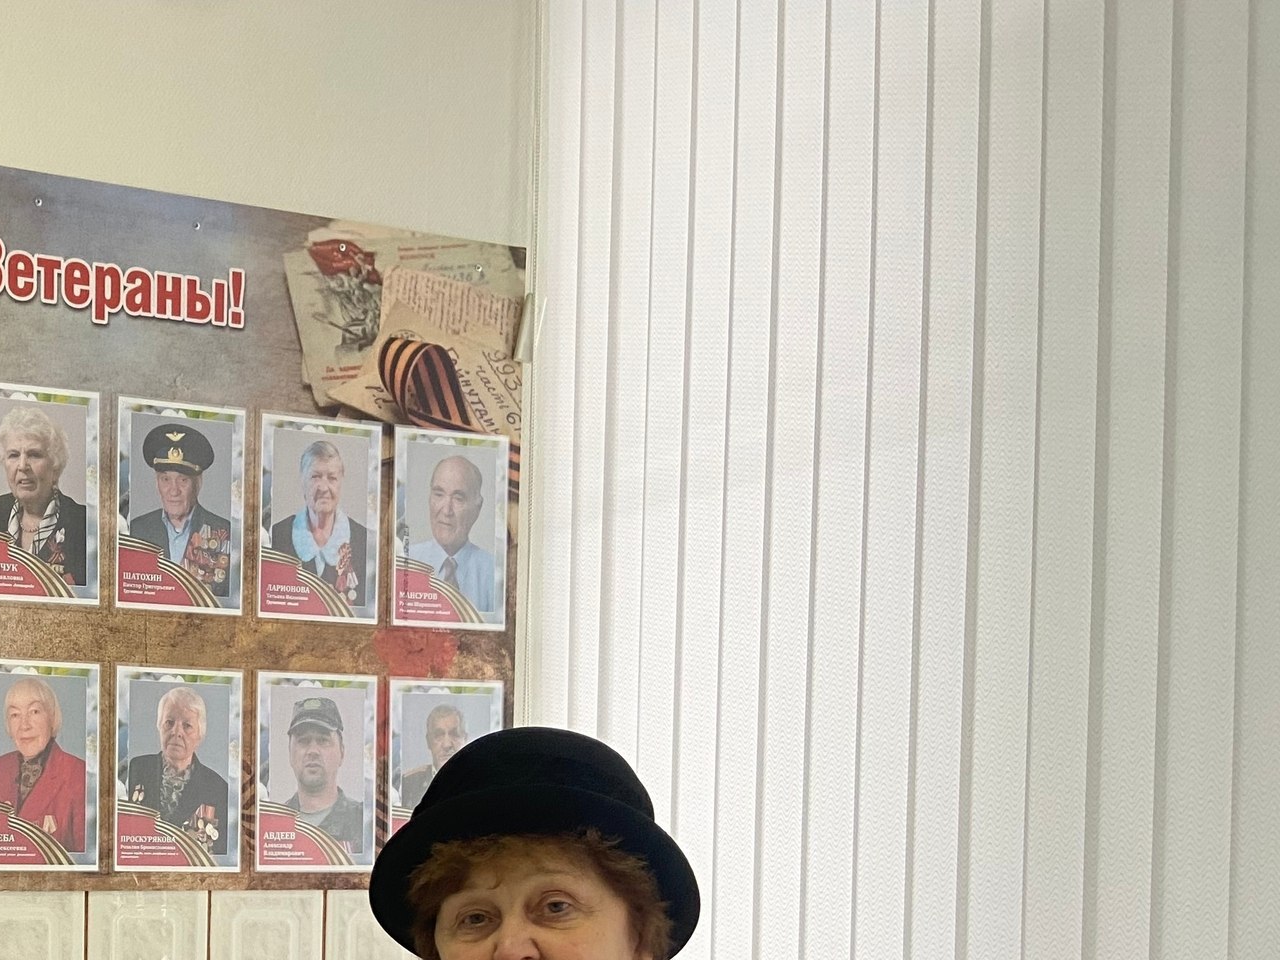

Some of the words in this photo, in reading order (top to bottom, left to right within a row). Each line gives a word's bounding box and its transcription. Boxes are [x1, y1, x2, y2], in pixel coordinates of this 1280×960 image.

[123, 572, 162, 582] ШАТОХИН
[267, 584, 310, 594] ЛАРИОНОВА
[263, 831, 296, 841] АВДЕЕВ
